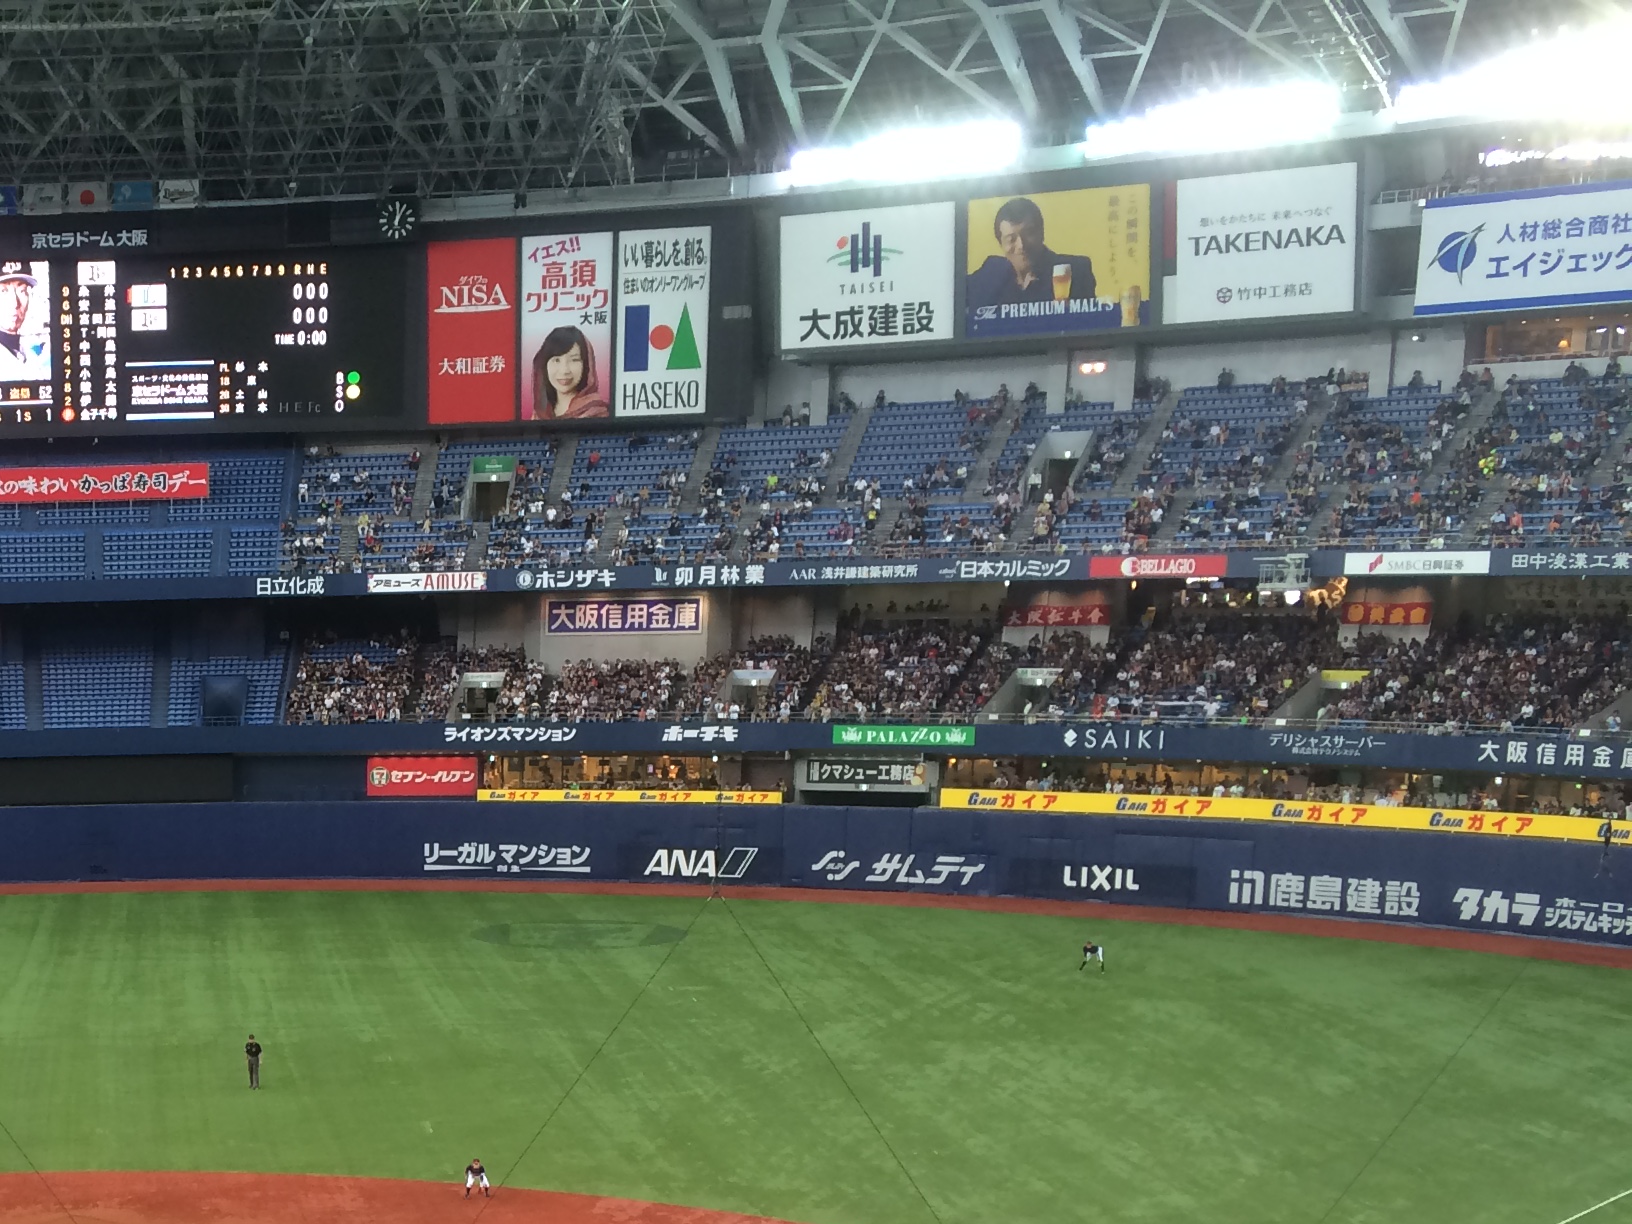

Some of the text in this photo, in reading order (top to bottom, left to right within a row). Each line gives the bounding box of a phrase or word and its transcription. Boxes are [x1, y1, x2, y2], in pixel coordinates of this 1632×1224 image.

[1199, 206, 1333, 228] 想いをかたちに 未来へつなぐ
[1496, 212, 1632, 245] 人材総合商社
[1187, 223, 1347, 258] TAKENAKA
[170, 267, 176, 279] 1
[182, 267, 190, 278] 2
[195, 266, 203, 278] 3
[209, 266, 218, 278] 4
[252, 265, 259, 277] 7
[293, 264, 301, 276] R
[306, 263, 315, 275] H
[319, 262, 327, 275] E
[541, 259, 596, 289] 高須
[293, 282, 329, 300] 0 0 0
[440, 283, 507, 309] NISA
[839, 280, 895, 296] TAISEI
[1237, 282, 1313, 301] 竹中工務店
[526, 288, 609, 313] クリニック
[1001, 299, 1066, 319] PREMIUM
[293, 306, 328, 324] 0 0 0
[579, 310, 608, 326] 大阪
[799, 300, 935, 343] 大成建設
[274, 330, 328, 346] TIME 0:00
[438, 355, 506, 375] 大和証券
[38, 385, 53, 399] 52
[335, 385, 344, 398] S
[622, 379, 699, 411] HASEKO
[674, 563, 766, 587] 卯月林業
[788, 568, 817, 581] AAR
[959, 558, 1071, 579] 日本カルミック
[1140, 557, 1196, 575] BELLAGIO
[256, 575, 325, 596] 日立化成
[372, 572, 480, 590] アミューズ AMUSE
[535, 568, 617, 589] ホシザキ
[550, 602, 699, 630] 大阪信用金庫
[444, 725, 577, 743] ライオンズマンション
[661, 725, 739, 742] ホーチキ
[866, 727, 942, 743] PALAZZO
[1083, 729, 1165, 750] SAIKI
[1268, 732, 1387, 750] デリシャスサーバー
[1477, 739, 1632, 769] 大阪信用金庫
[820, 763, 916, 782] クマシュー工務店
[1001, 794, 1059, 810] ガイア
[1151, 798, 1213, 816] ガイア
[1306, 805, 1369, 823] ガイア
[1468, 814, 1534, 834] ガイア
[643, 848, 717, 876] ANA
[864, 852, 986, 886] サムティ
[1063, 864, 1140, 892] LIXIL
[1268, 871, 1421, 918] 鹿島建設
[1452, 887, 1542, 927] タカラ
